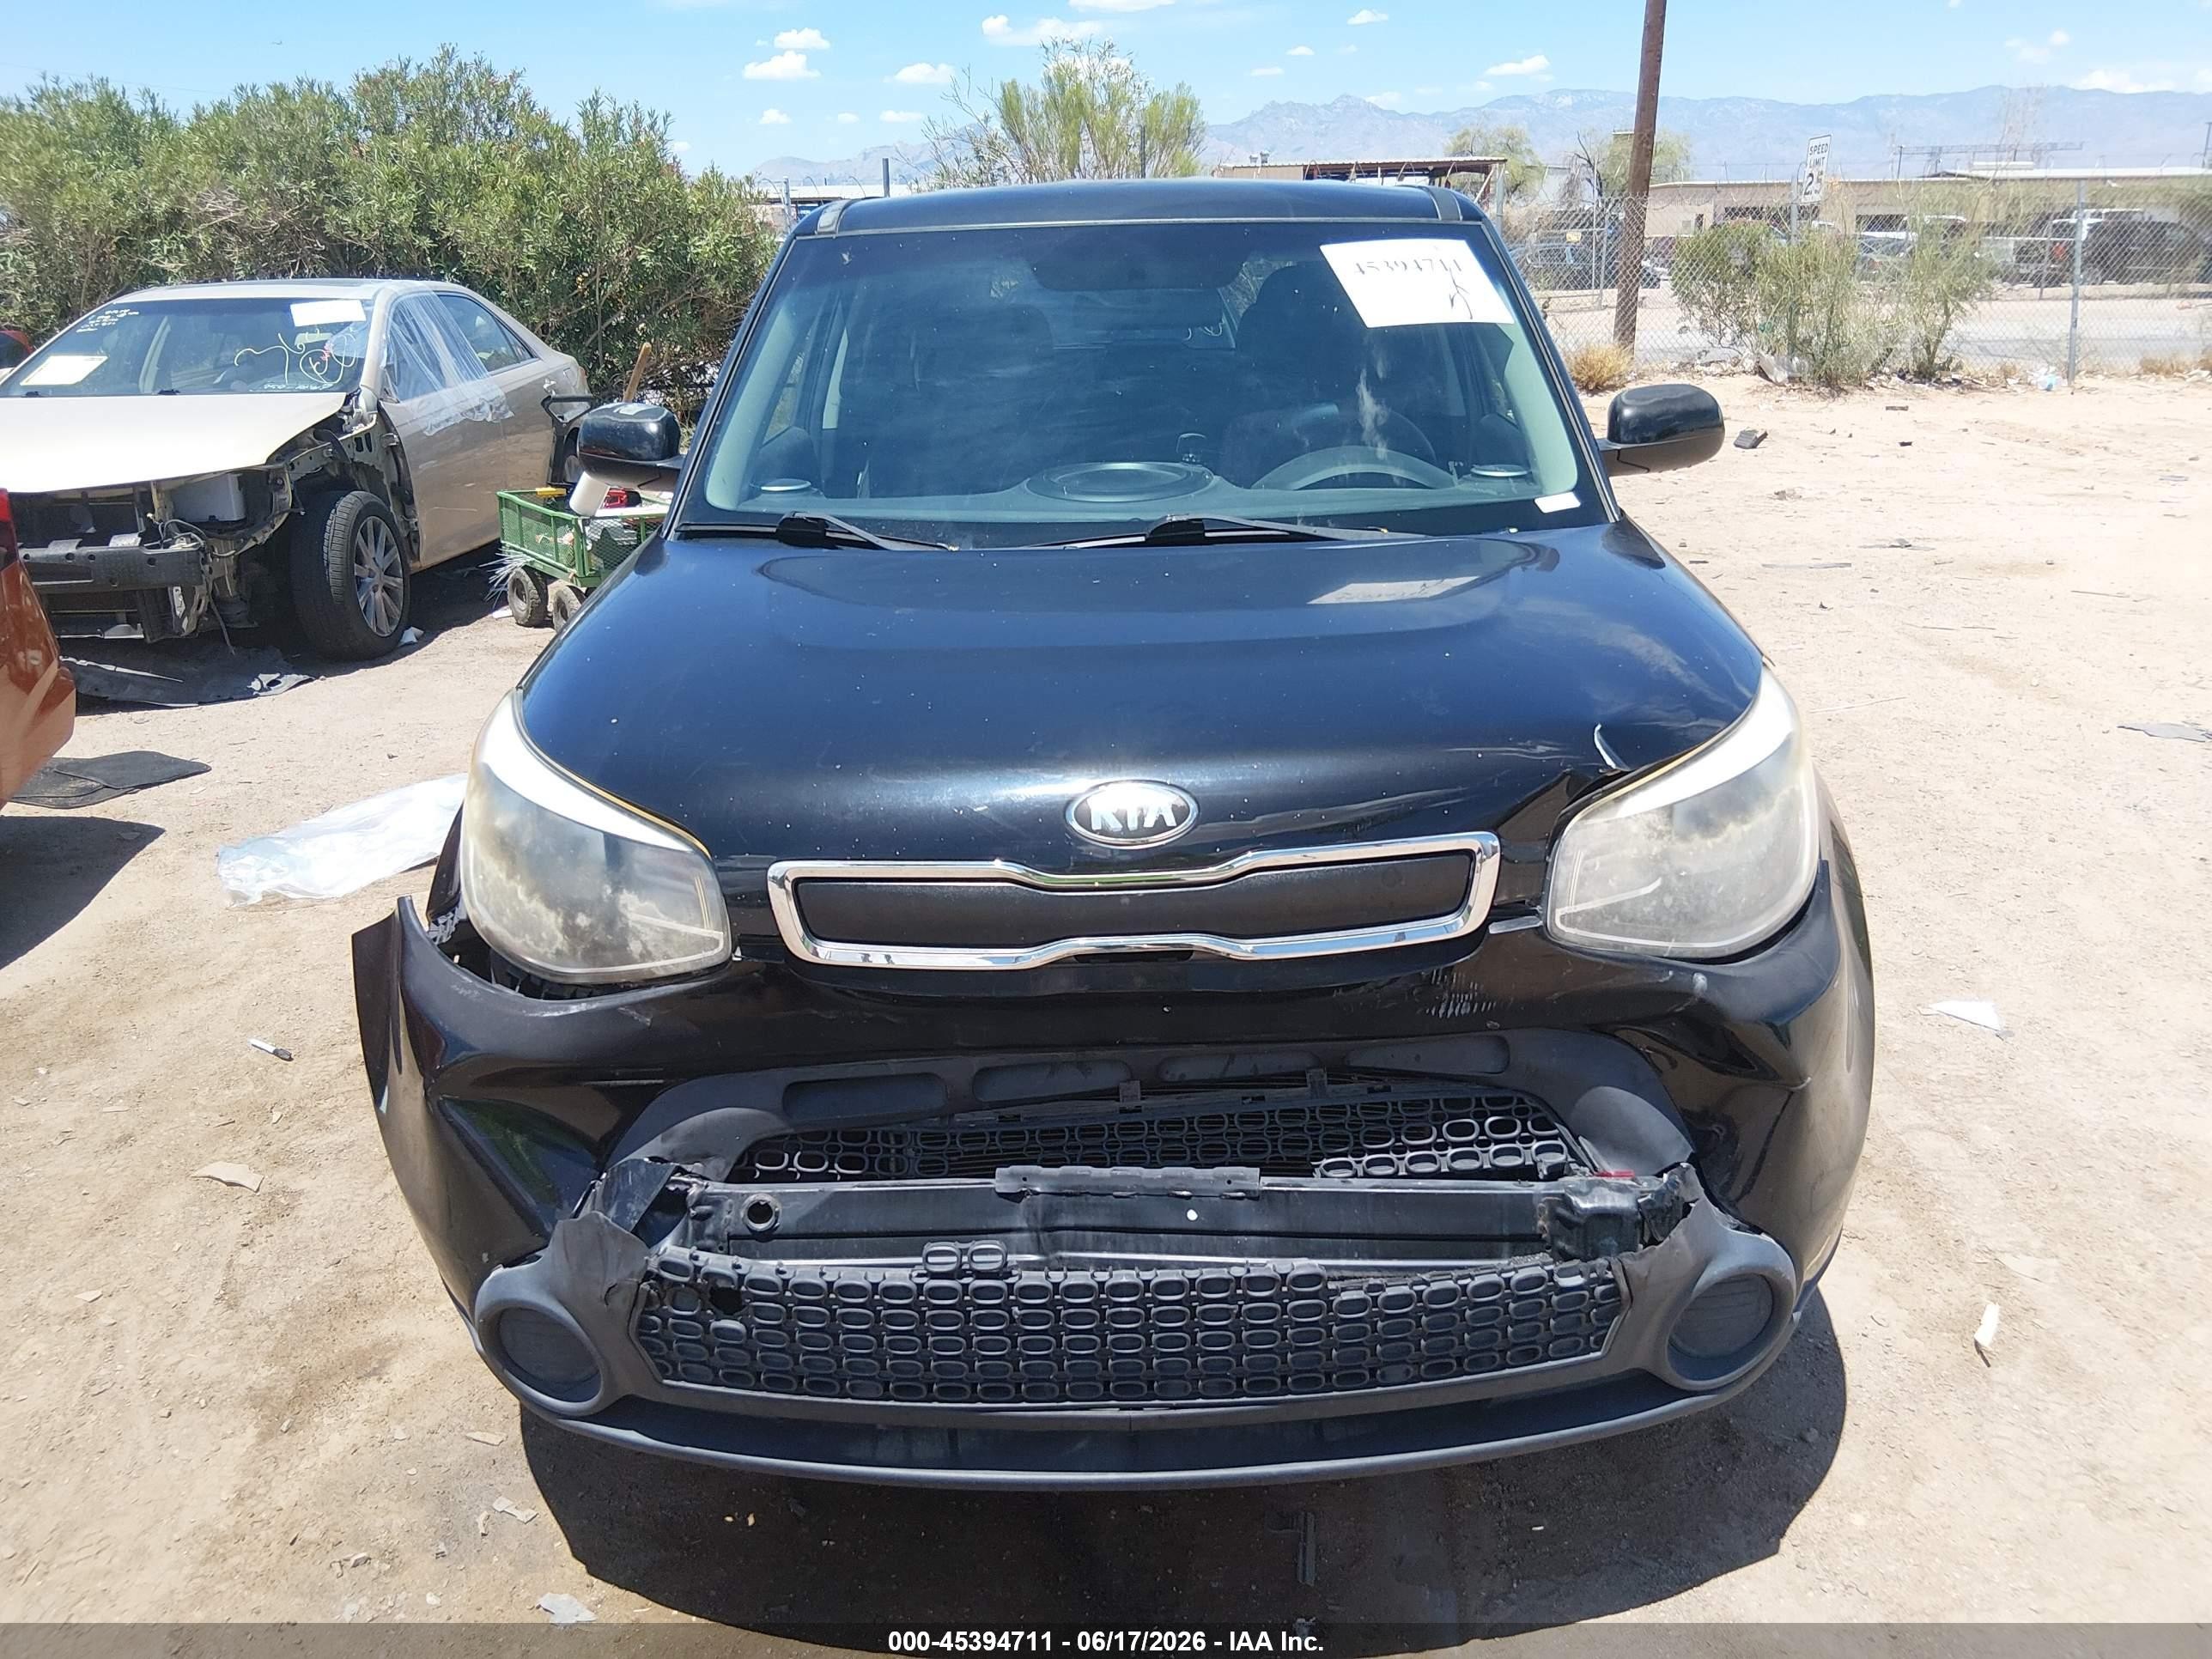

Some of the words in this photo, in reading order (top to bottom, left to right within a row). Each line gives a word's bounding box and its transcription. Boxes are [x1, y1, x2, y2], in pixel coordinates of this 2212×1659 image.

[1809, 143, 1828, 155] SPEED
[1809, 157, 1825, 167] LIMIT
[1087, 793, 1177, 832] KIA
